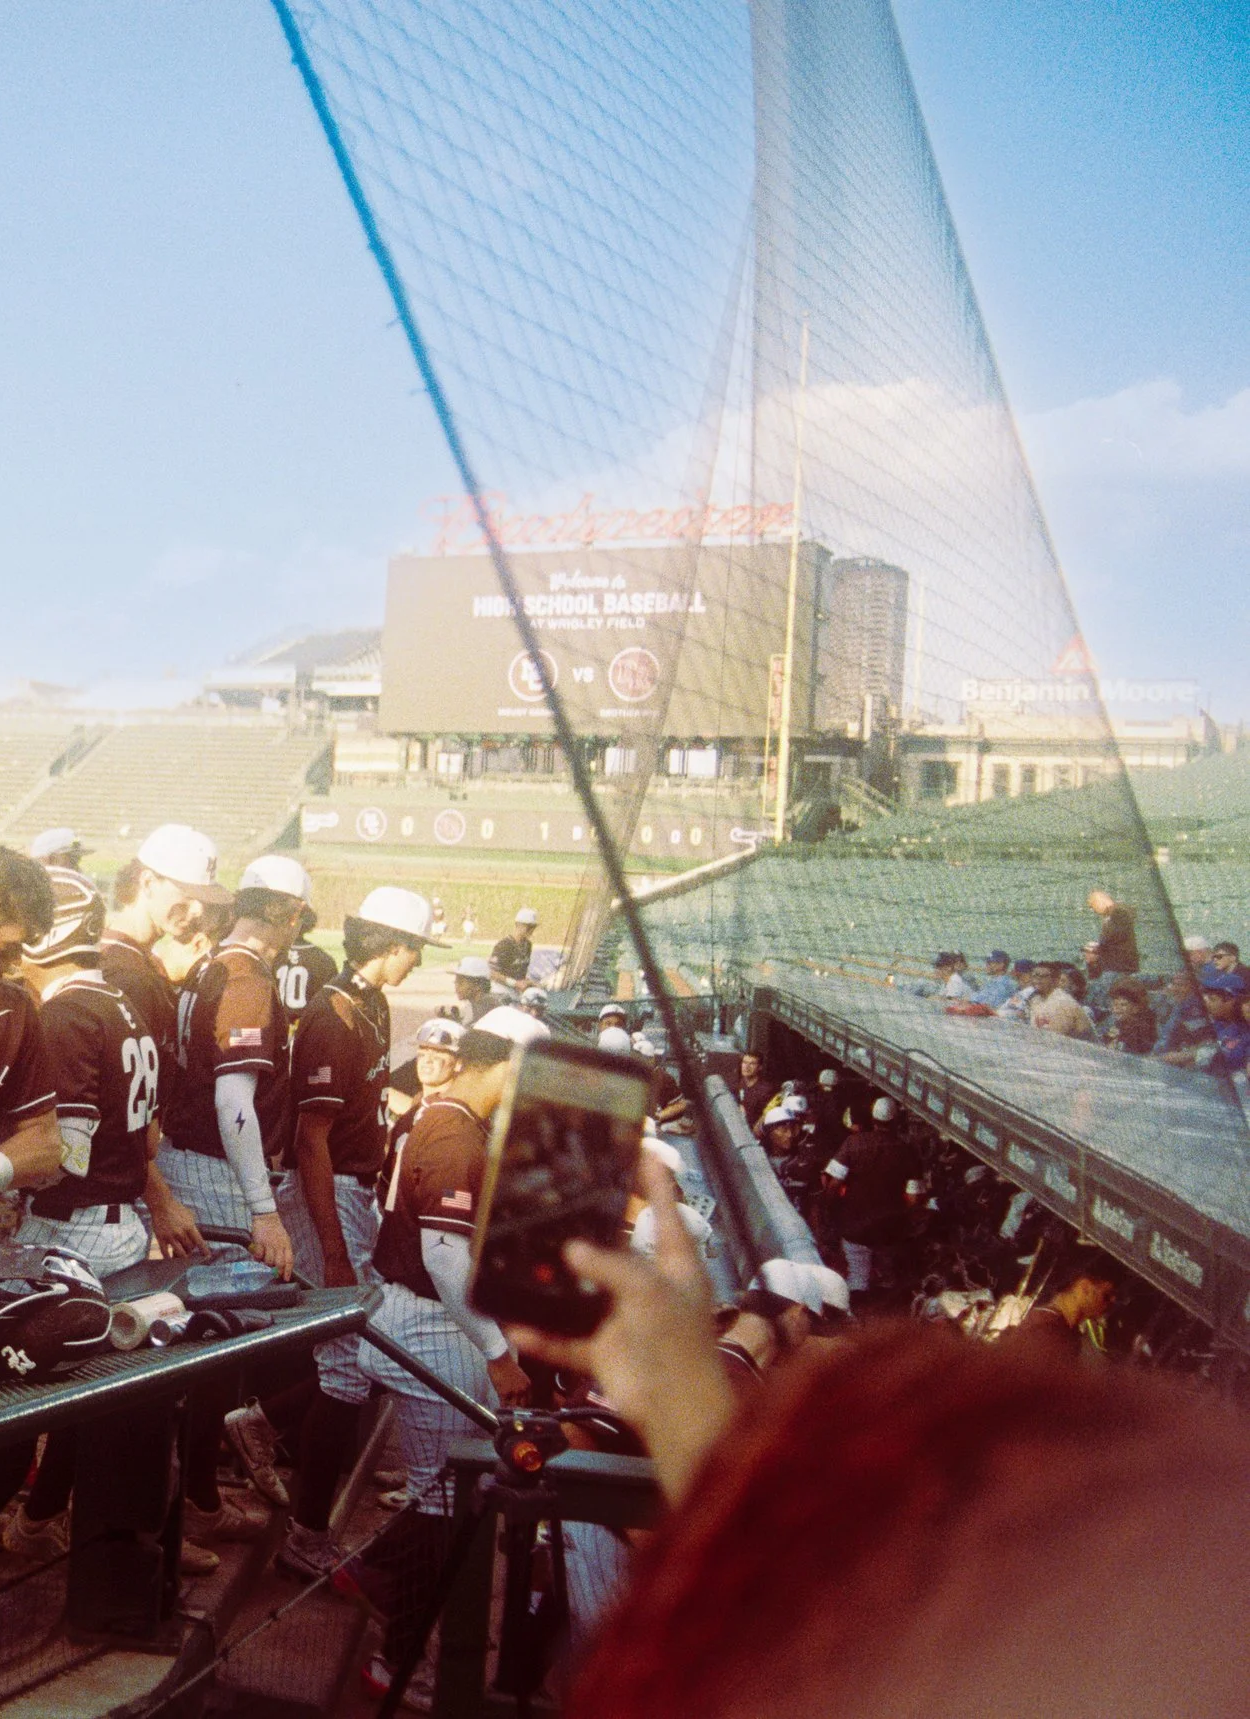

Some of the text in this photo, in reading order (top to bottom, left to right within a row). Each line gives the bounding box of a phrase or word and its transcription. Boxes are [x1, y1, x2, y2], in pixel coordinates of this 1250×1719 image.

[524, 594, 600, 616] SCHOOL
[960, 678, 1196, 706] Benjamin Moore
[276, 965, 309, 1009] 10
